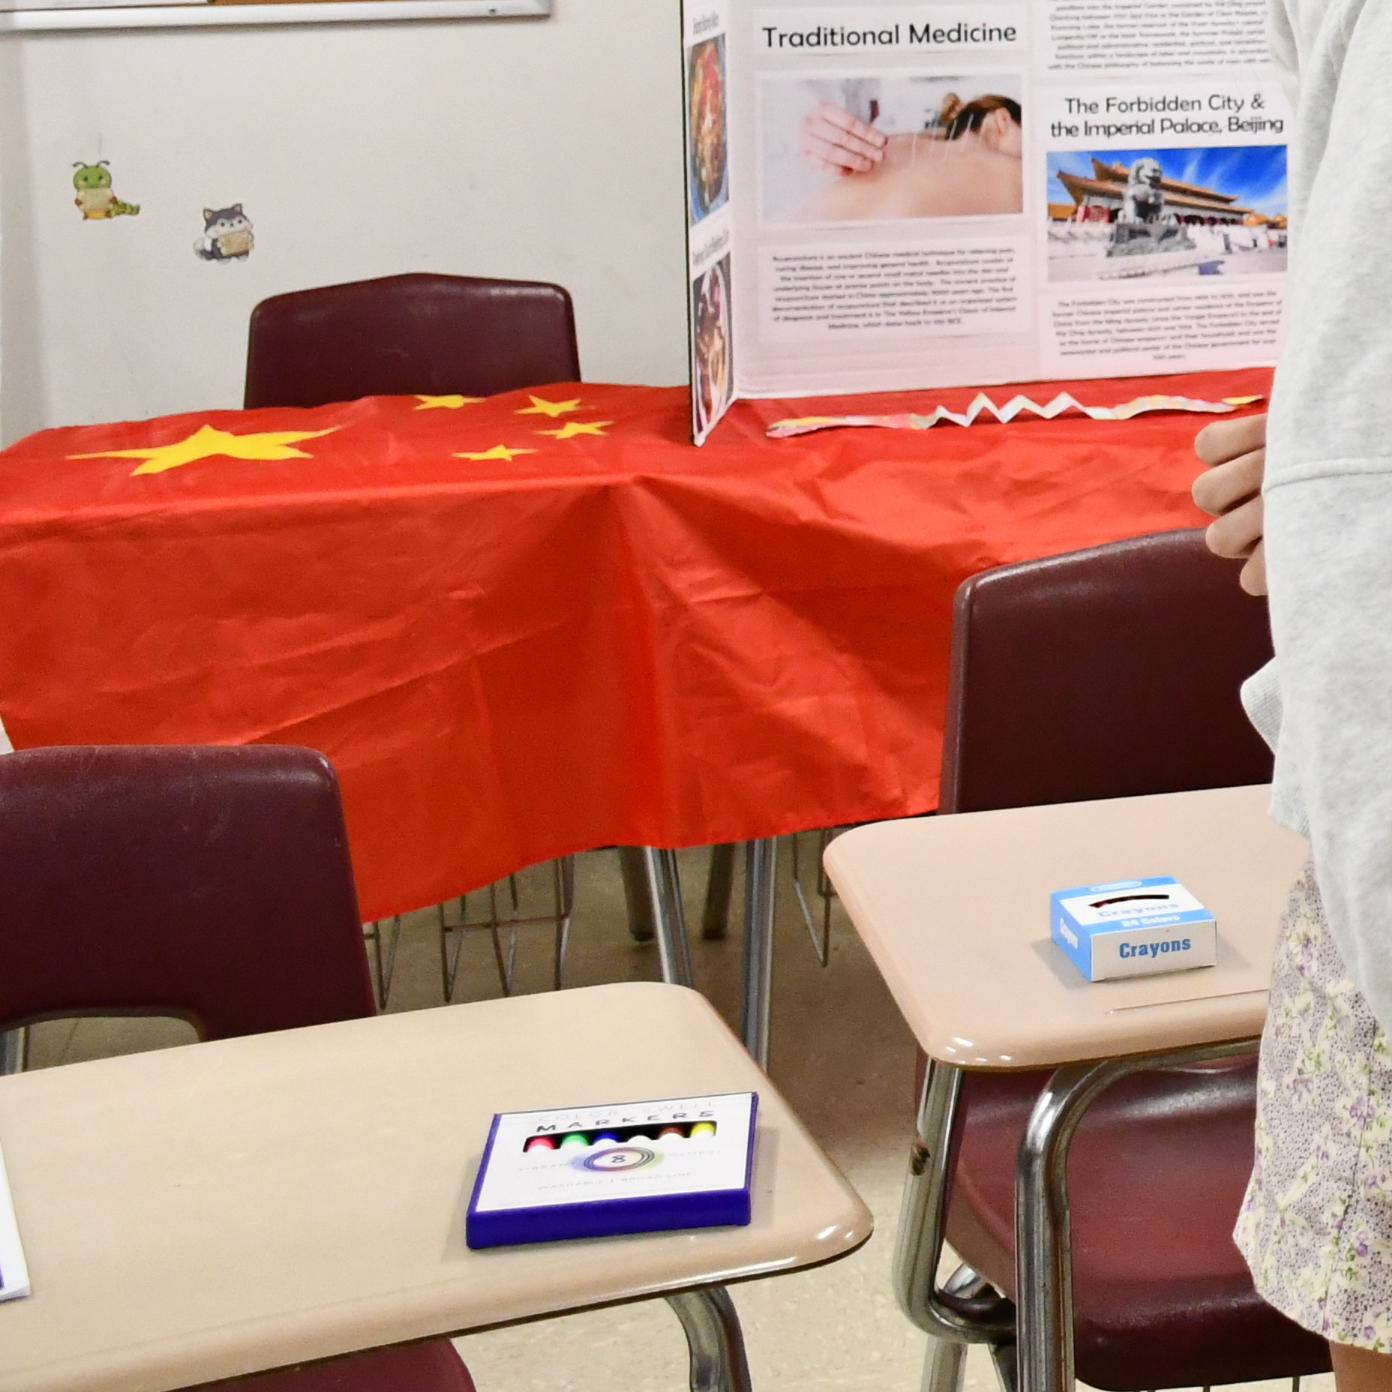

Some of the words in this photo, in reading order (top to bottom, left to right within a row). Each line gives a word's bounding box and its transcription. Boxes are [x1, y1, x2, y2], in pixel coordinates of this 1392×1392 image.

[762, 24, 900, 48] Traditional
[908, 22, 1017, 44] Medicine
[1065, 98, 1099, 114] The
[1106, 96, 1202, 113] Forbidden
[1208, 94, 1245, 114] City
[1250, 94, 1264, 110] &
[1050, 122, 1079, 138] the
[1084, 120, 1154, 139] Imperial
[1160, 118, 1222, 135] Palace,
[1227, 116, 1284, 134] Beijing
[1119, 937, 1191, 959] Crayons
[536, 1110, 715, 1133] MARKERS
[611, 1154, 625, 1163] 8
